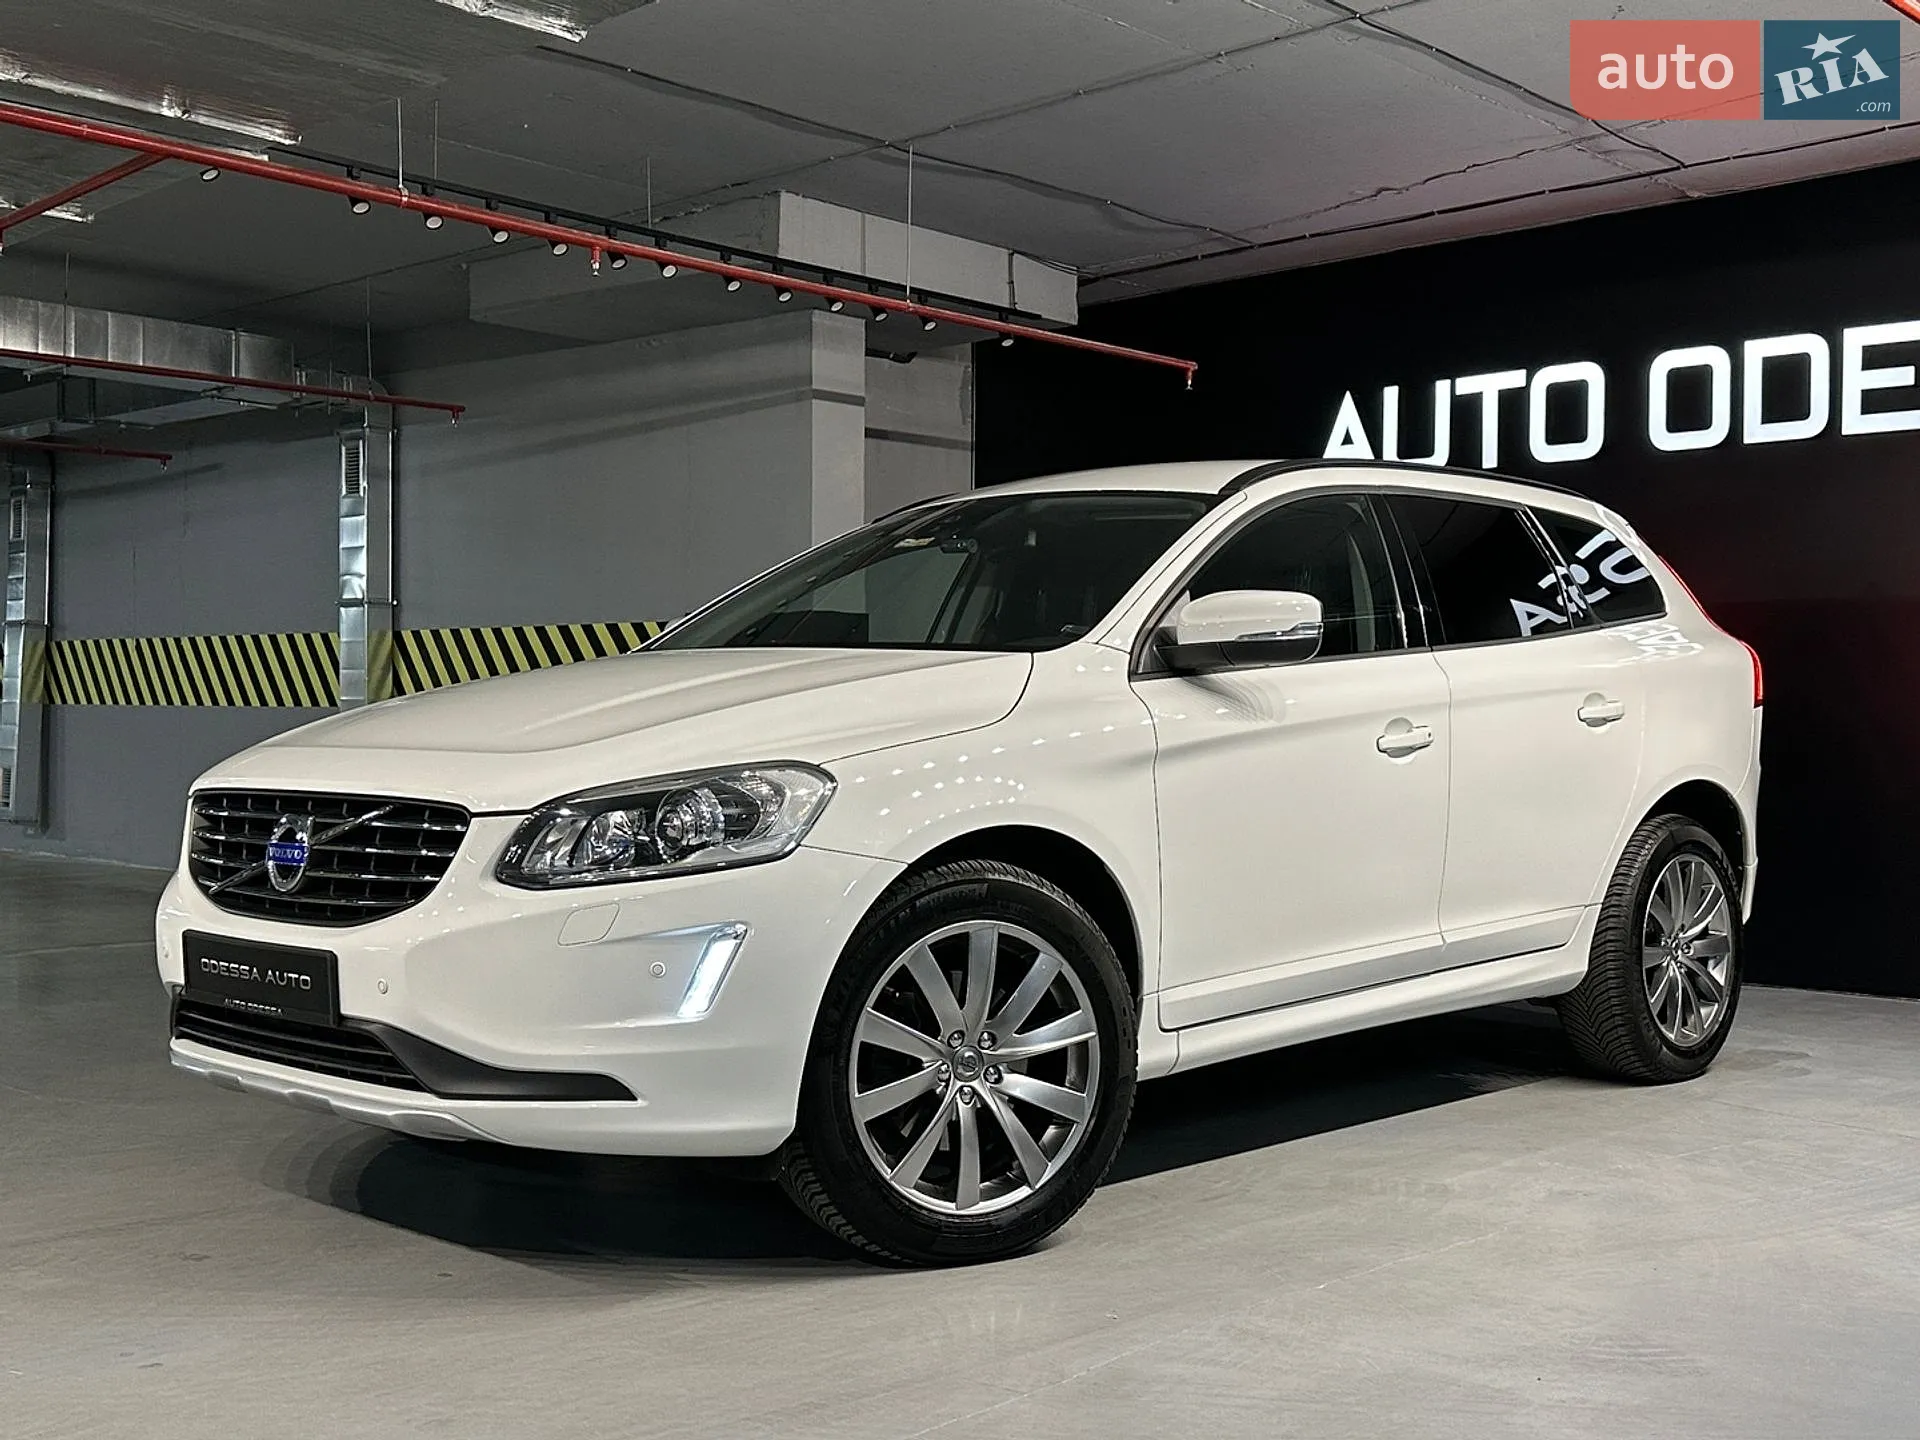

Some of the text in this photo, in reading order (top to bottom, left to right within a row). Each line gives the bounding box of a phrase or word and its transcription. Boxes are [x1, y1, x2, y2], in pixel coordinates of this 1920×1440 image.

[1322, 320, 1920, 469] AUTO ODE
[268, 846, 303, 860] VOLVO
[200, 957, 311, 991] ODESSA AUTO
